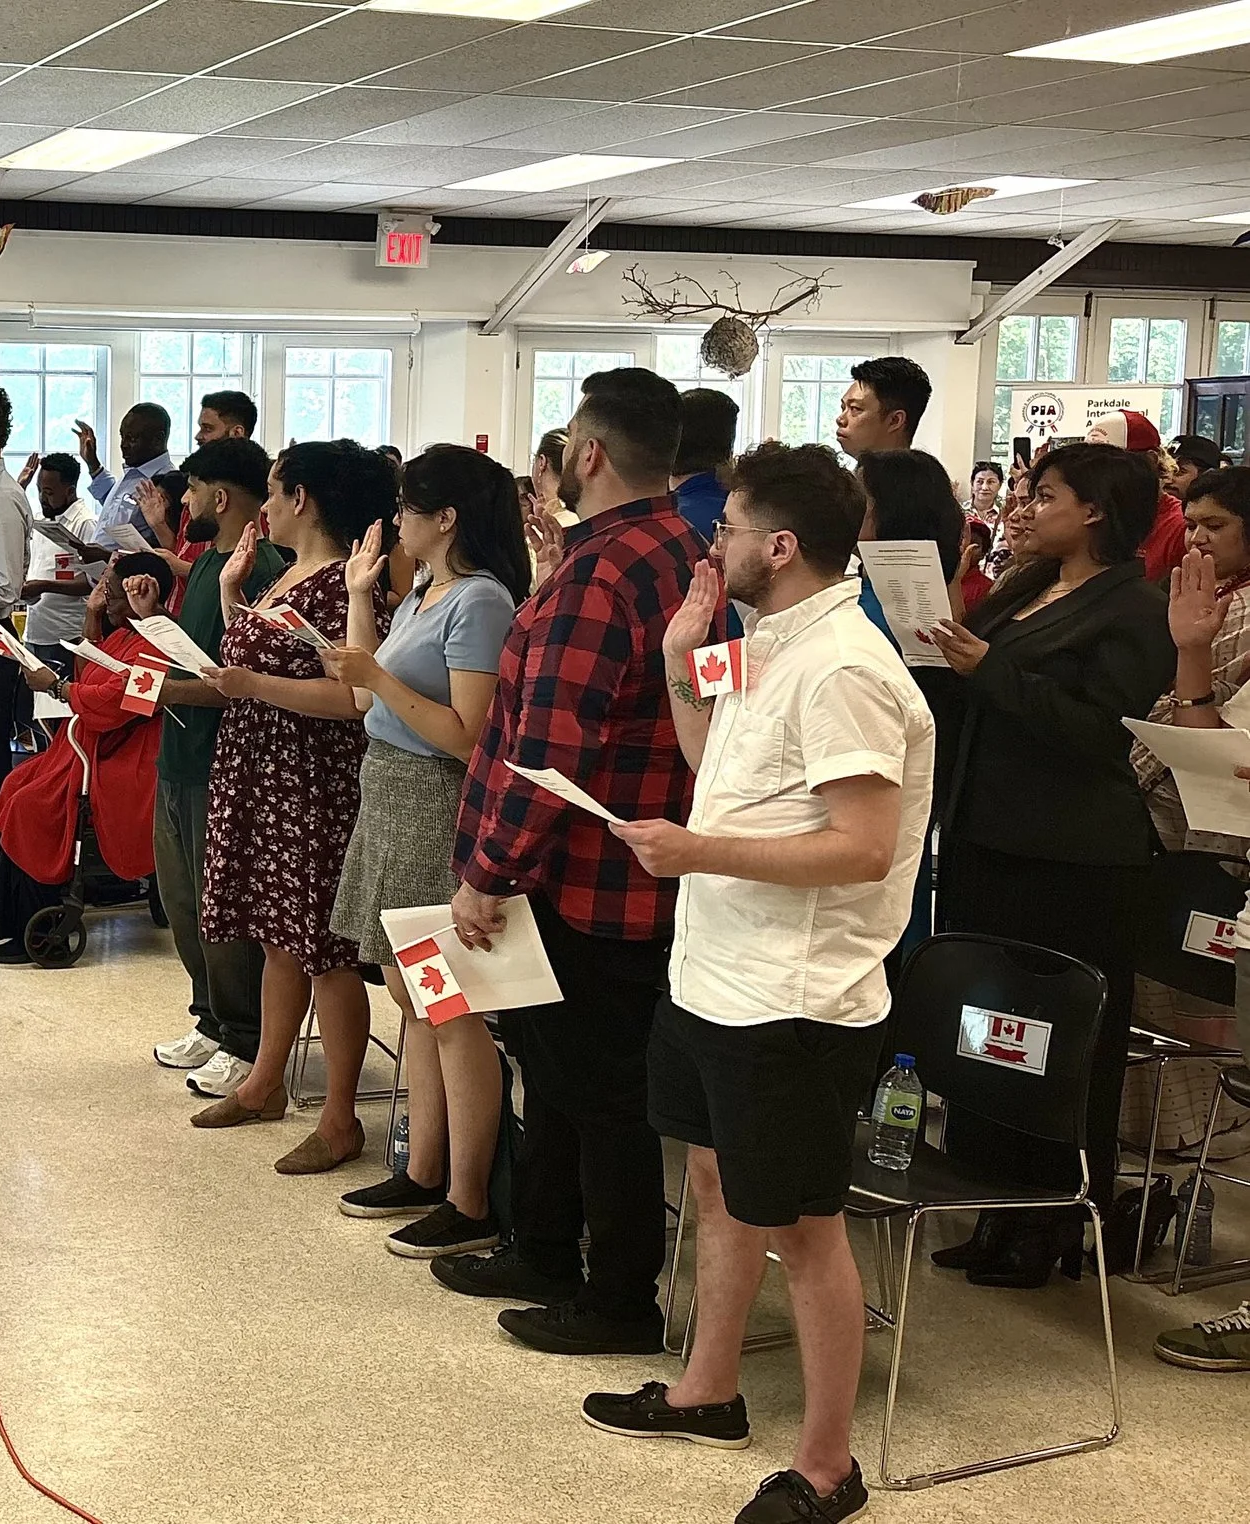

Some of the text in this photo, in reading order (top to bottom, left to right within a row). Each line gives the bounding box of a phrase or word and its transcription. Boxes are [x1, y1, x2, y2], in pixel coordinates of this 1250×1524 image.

[387, 232, 424, 264] EXIT
[1087, 399, 1131, 407] Parkdale
[1031, 405, 1056, 415] PIA
[893, 1107, 914, 1117] NAYA
